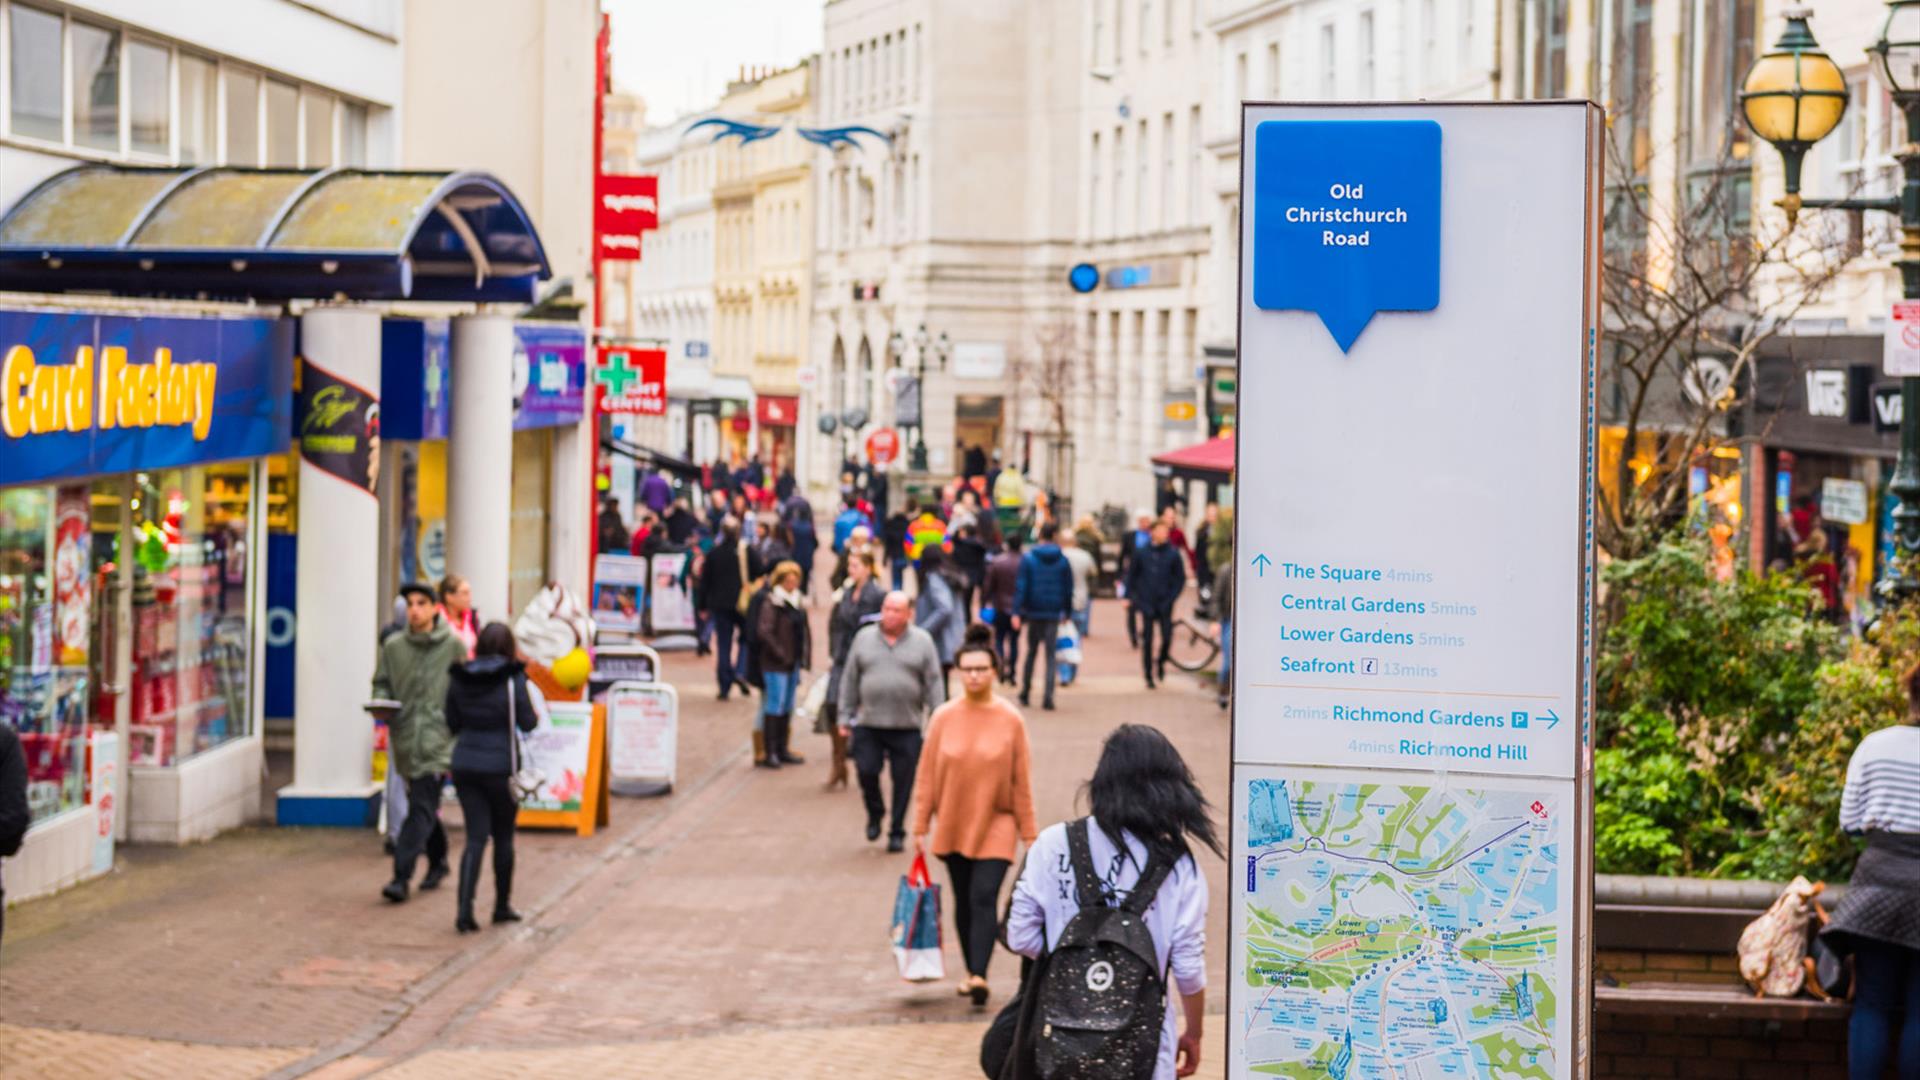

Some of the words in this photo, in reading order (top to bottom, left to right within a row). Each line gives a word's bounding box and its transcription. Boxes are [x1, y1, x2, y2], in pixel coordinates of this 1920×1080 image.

[1329, 183, 1363, 200] Old
[1285, 206, 1408, 222] Christchurch
[1322, 230, 1370, 246] Road
[1, 344, 94, 438] Card
[100, 345, 217, 441] Factory
[1282, 562, 1315, 579] The
[1320, 564, 1382, 583] Square
[1386, 568, 1433, 583] 4mins
[1281, 594, 1346, 611] Central
[1351, 596, 1426, 614] Gardens
[1430, 601, 1477, 616] 5mins
[1280, 625, 1335, 642] Lower
[1340, 627, 1414, 645] Gardens
[1418, 632, 1465, 647] 5mins
[1280, 656, 1355, 674] Seafront
[1383, 662, 1438, 678] 13mins
[1283, 705, 1328, 720] 2mins
[1333, 705, 1424, 724] Richmond
[1429, 709, 1504, 728] Gardens
[1348, 739, 1394, 754] 4mins
[1399, 739, 1491, 759] Richmond
[1497, 743, 1528, 760] Hill
[1335, 928, 1365, 936] Gardens
[1339, 919, 1361, 927] Lower
[1431, 924, 1445, 932] The
[1446, 925, 1472, 934] Square
[1255, 967, 1288, 977] Westover
[1291, 969, 1309, 977] Road
